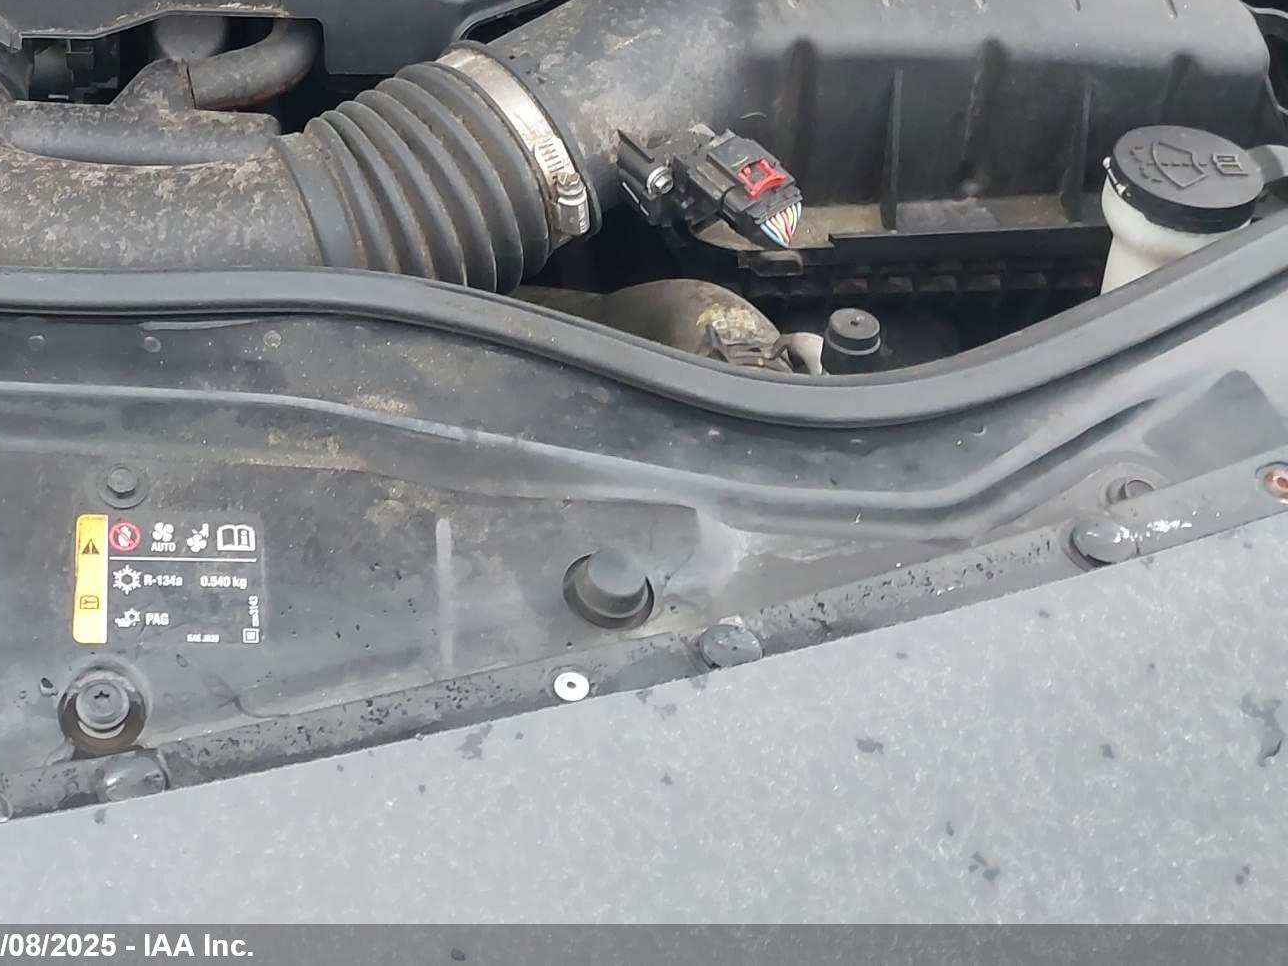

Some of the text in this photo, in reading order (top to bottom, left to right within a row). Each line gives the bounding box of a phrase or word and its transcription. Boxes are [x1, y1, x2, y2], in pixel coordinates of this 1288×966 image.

[151, 542, 176, 552] AUTO
[143, 574, 248, 590] R-134a 0.540 kg
[145, 613, 170, 626] PAG
